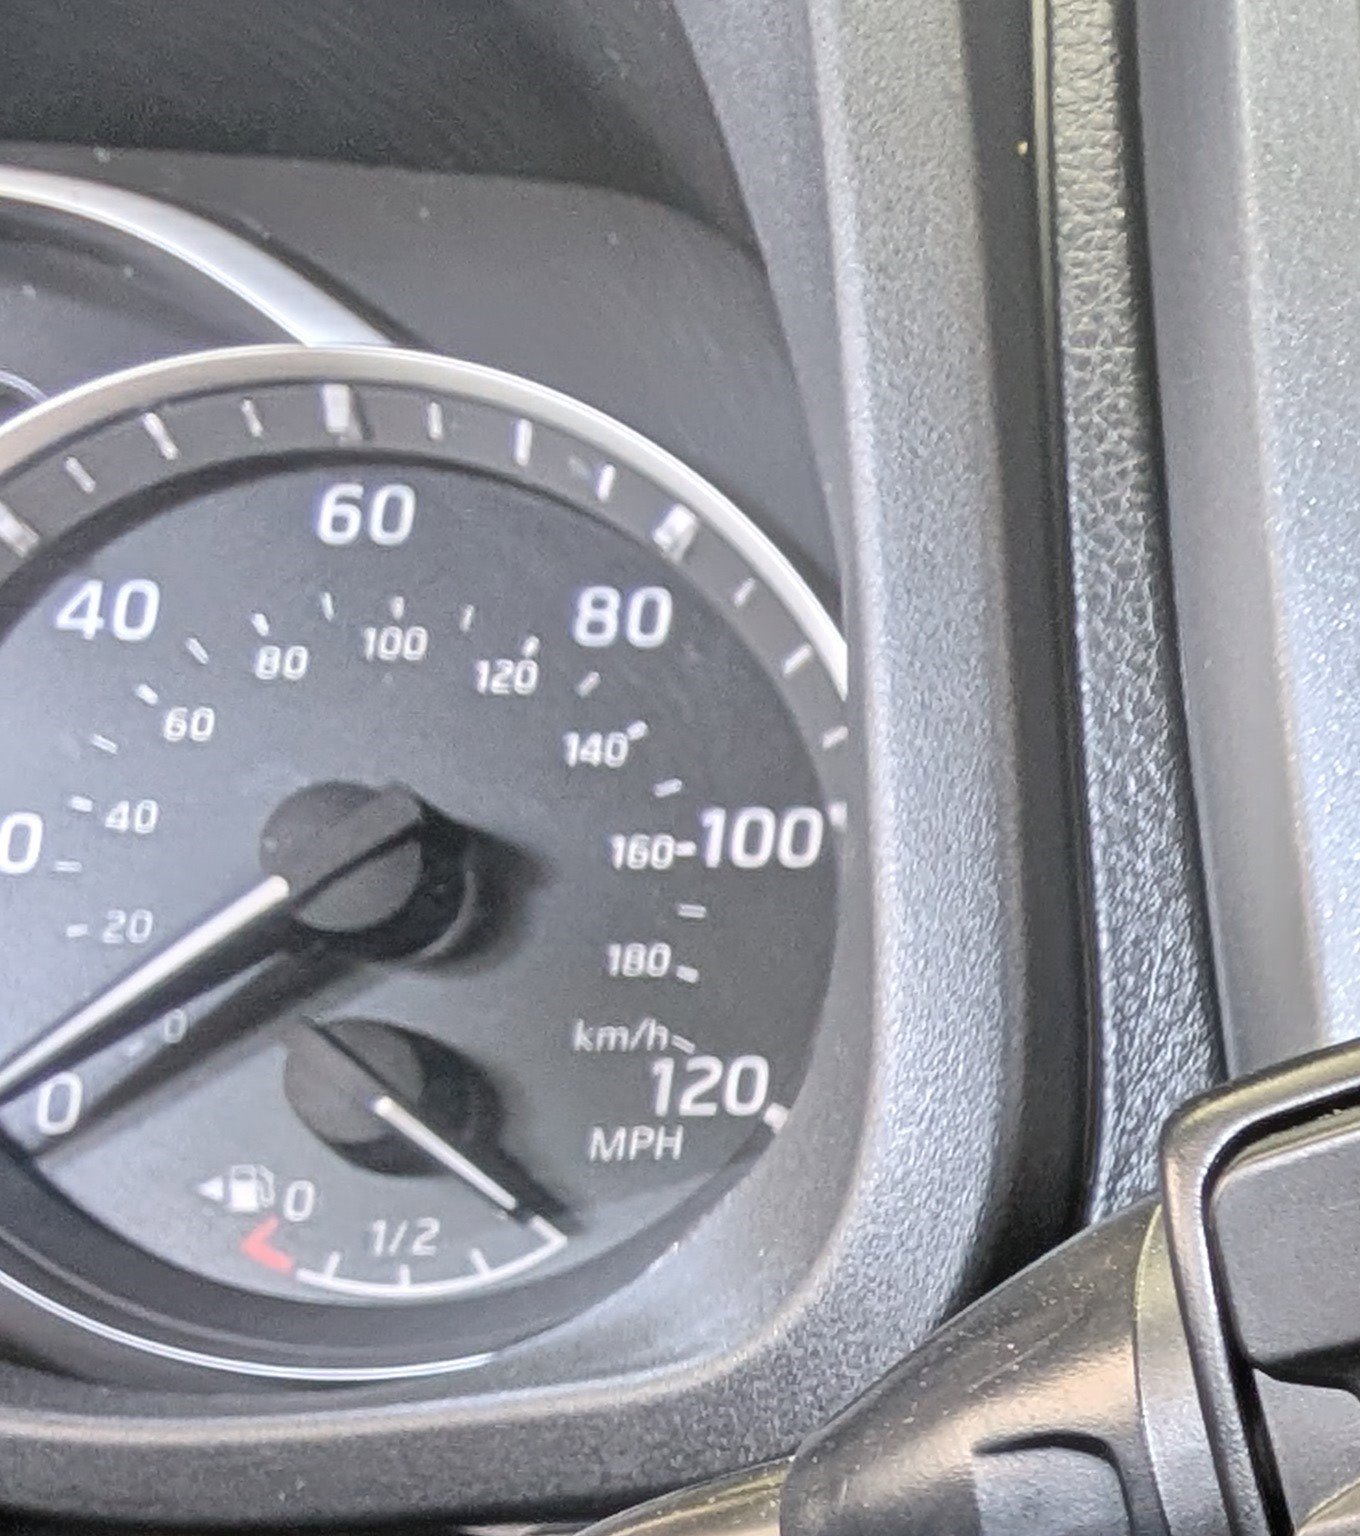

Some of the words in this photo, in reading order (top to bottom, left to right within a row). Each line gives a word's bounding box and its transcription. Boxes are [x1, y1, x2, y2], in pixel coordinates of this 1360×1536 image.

[317, 484, 415, 546] 60
[55, 579, 160, 640] 40
[572, 586, 672, 648] 80
[364, 626, 427, 660] 100
[255, 645, 309, 681] 80
[475, 660, 538, 695] 120
[162, 706, 215, 742] 60
[564, 734, 628, 767] 140
[104, 800, 158, 834] 40
[611, 834, 673, 869] 160
[700, 808, 823, 868] 100
[103, 910, 153, 944] 20
[573, 1018, 669, 1054] km/h
[36, 1071, 84, 1136] 0
[651, 1056, 770, 1117] 120
[589, 1126, 683, 1161] MPH
[282, 1179, 315, 1222] 0
[368, 1217, 441, 1254] 1/2
